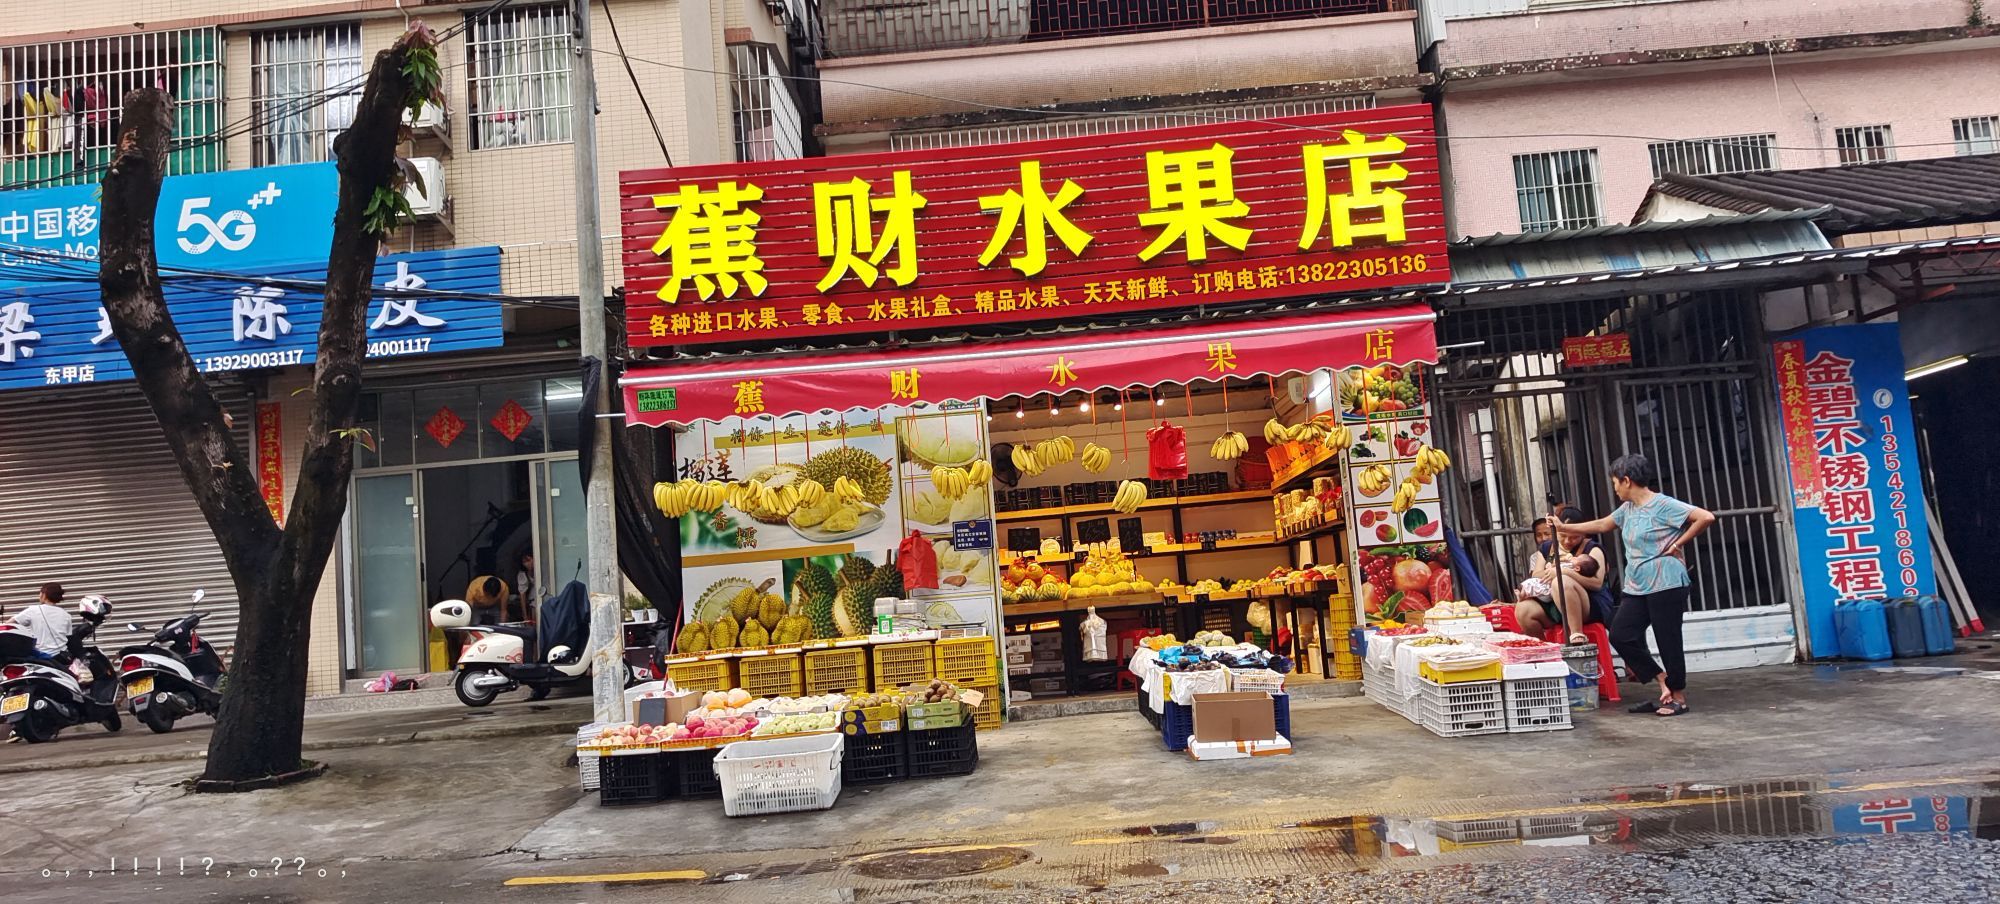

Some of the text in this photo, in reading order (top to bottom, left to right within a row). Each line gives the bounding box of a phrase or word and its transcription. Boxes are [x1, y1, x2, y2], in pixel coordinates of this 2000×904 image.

[1, 204, 98, 243] 中国移
[651, 129, 1409, 303] 蕉财水果店
[64, 239, 100, 260] Mo
[45, 364, 96, 385] 东甲店
[731, 327, 1395, 414] 蕉财水果店
[1804, 349, 1888, 605] 金碧不锈钢工程
